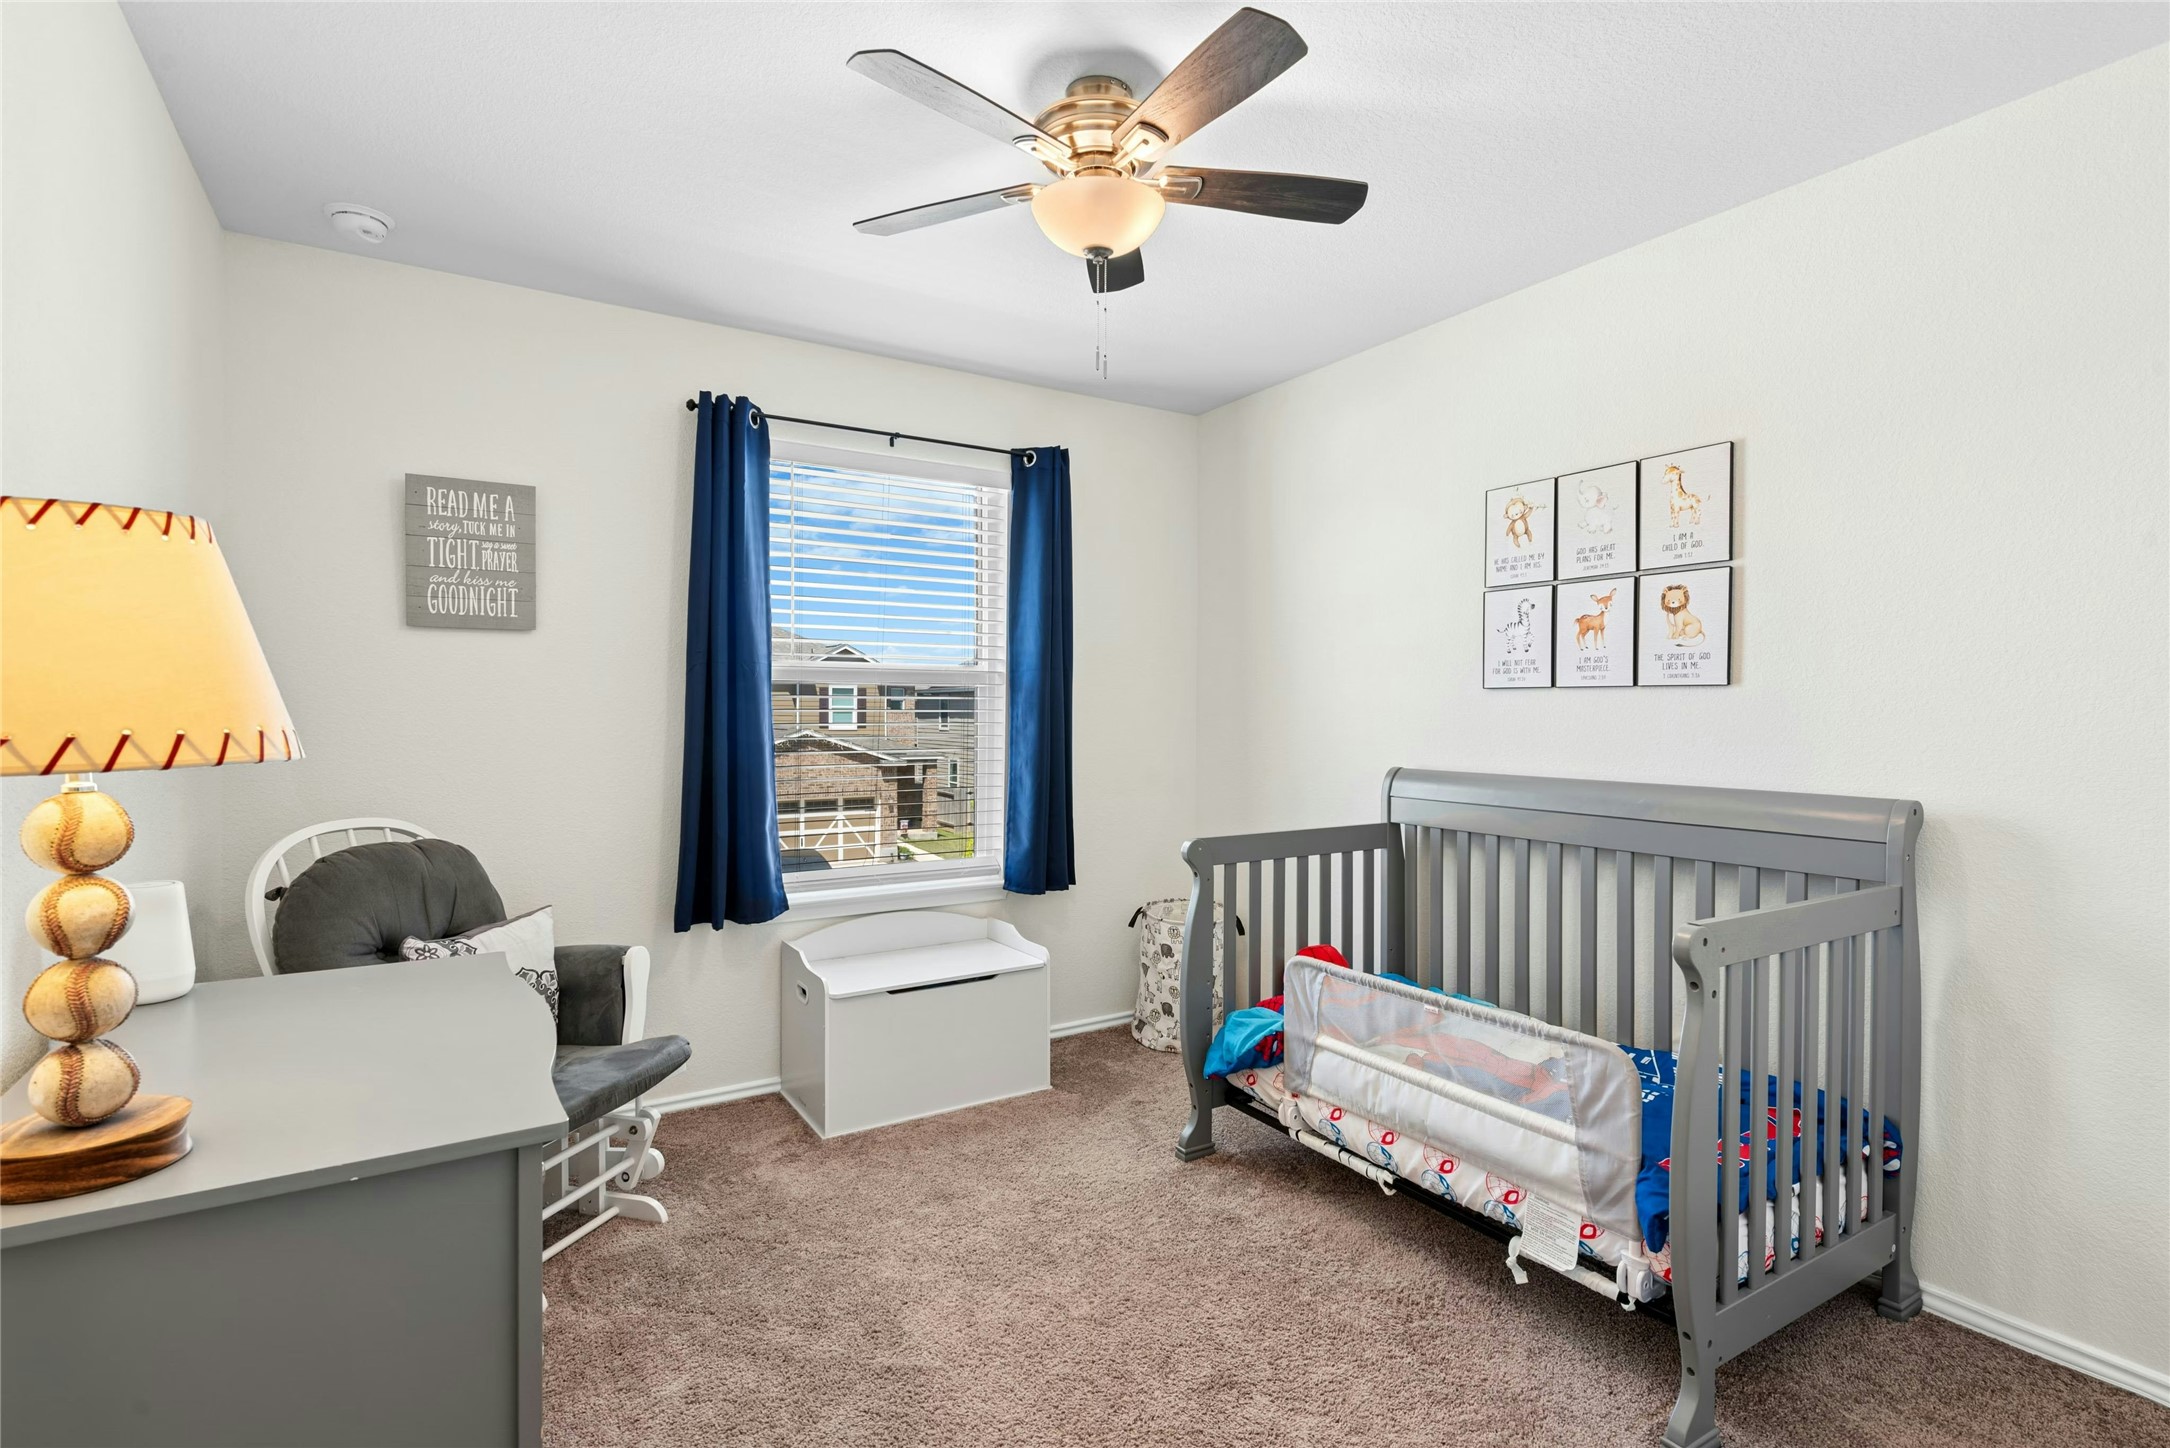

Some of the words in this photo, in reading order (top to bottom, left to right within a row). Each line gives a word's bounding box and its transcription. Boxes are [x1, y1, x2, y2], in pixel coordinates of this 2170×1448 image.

[427, 487, 468, 517] READ
[473, 492, 498, 520] ME
[505, 496, 515, 521] A
[428, 520, 462, 538] story,
[463, 520, 486, 535] TUCK
[490, 524, 503, 536] ME
[506, 524, 515, 537] IN
[427, 537, 480, 571] TIGHT,
[1600, 544, 1616, 552] GREAT
[1662, 543, 1678, 552] CHILD
[482, 550, 518, 572] PRAYER
[430, 570, 460, 584] and
[463, 570, 492, 586] kiss
[427, 584, 518, 617] GOODNIGHT
